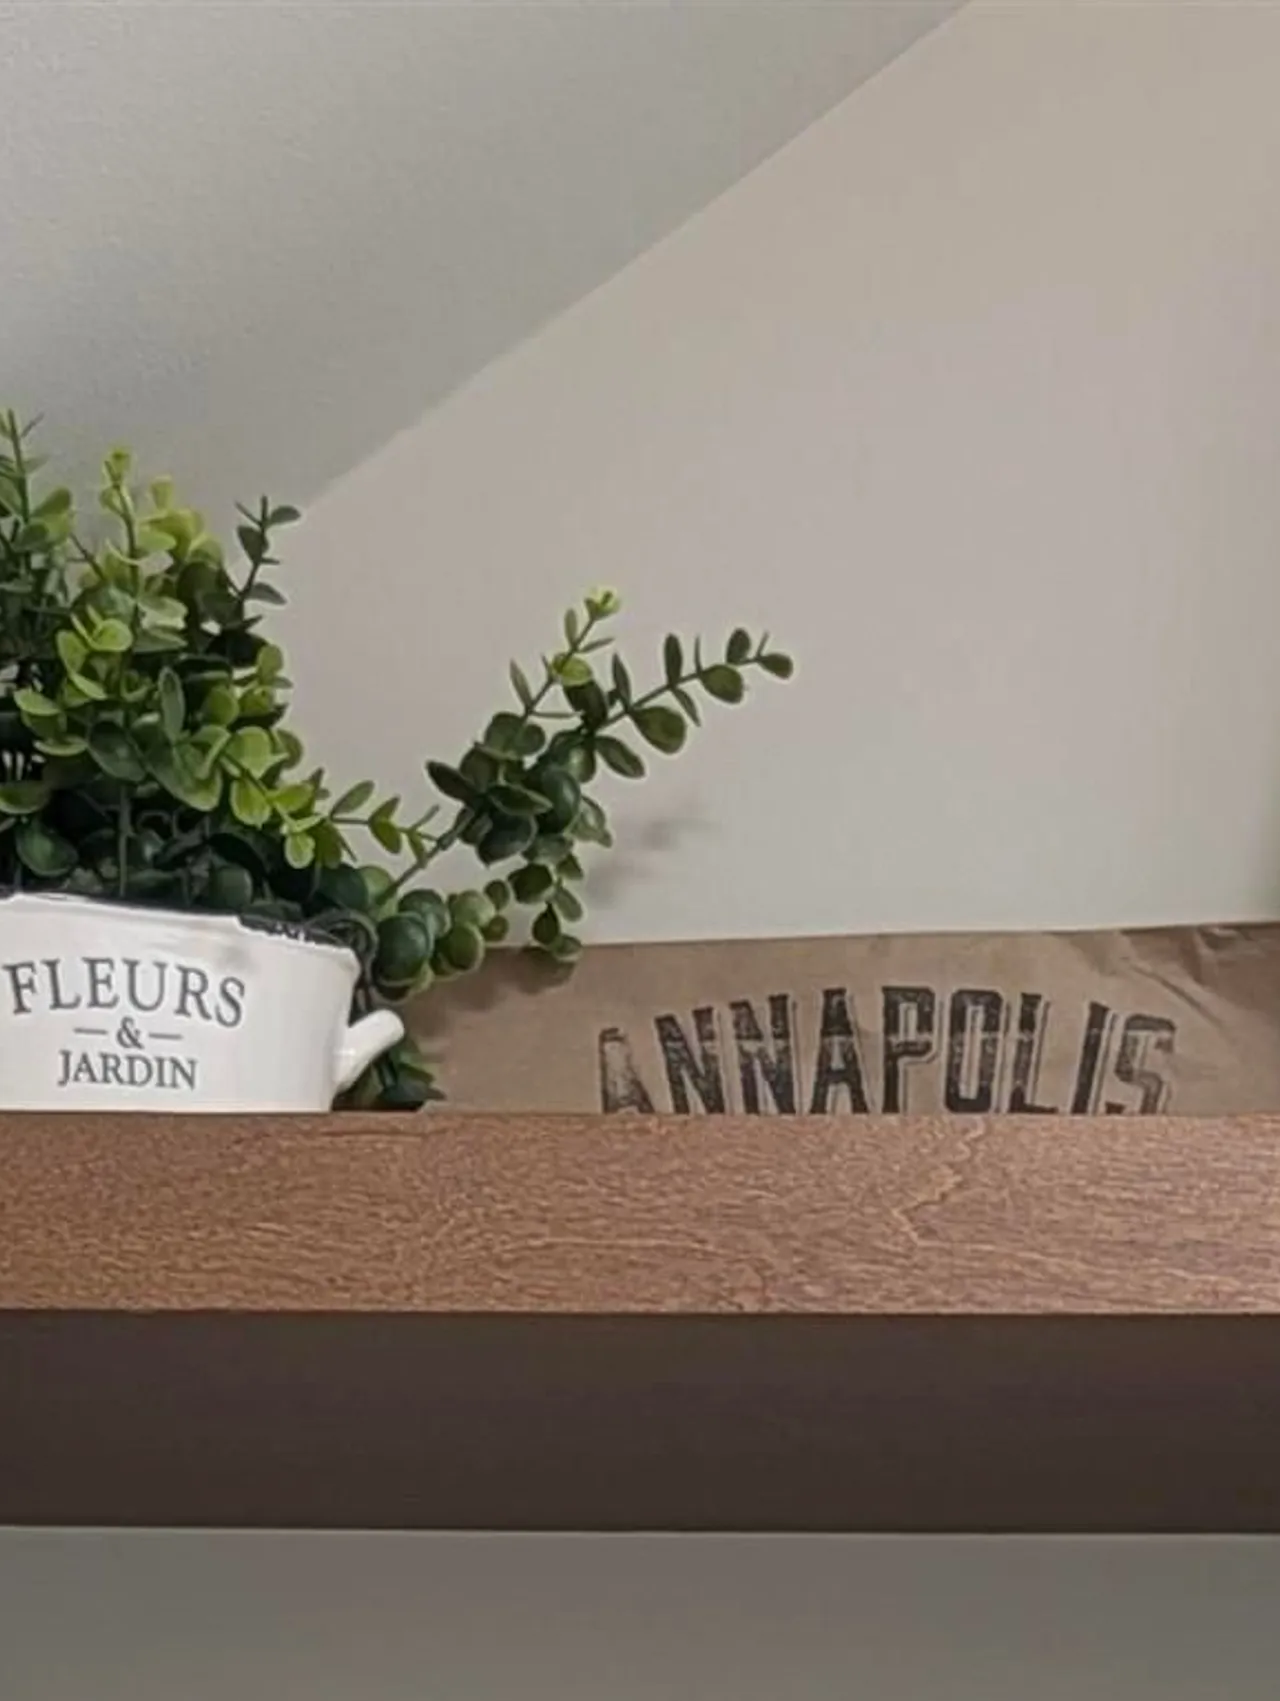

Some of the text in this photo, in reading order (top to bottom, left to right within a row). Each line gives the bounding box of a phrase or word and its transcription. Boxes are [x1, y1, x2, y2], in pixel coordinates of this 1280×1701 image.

[1, 956, 247, 1029] FLEURS
[116, 1017, 144, 1049] &
[598, 985, 1178, 1116] ANNAPOLIS
[57, 1050, 197, 1091] JARDIN
